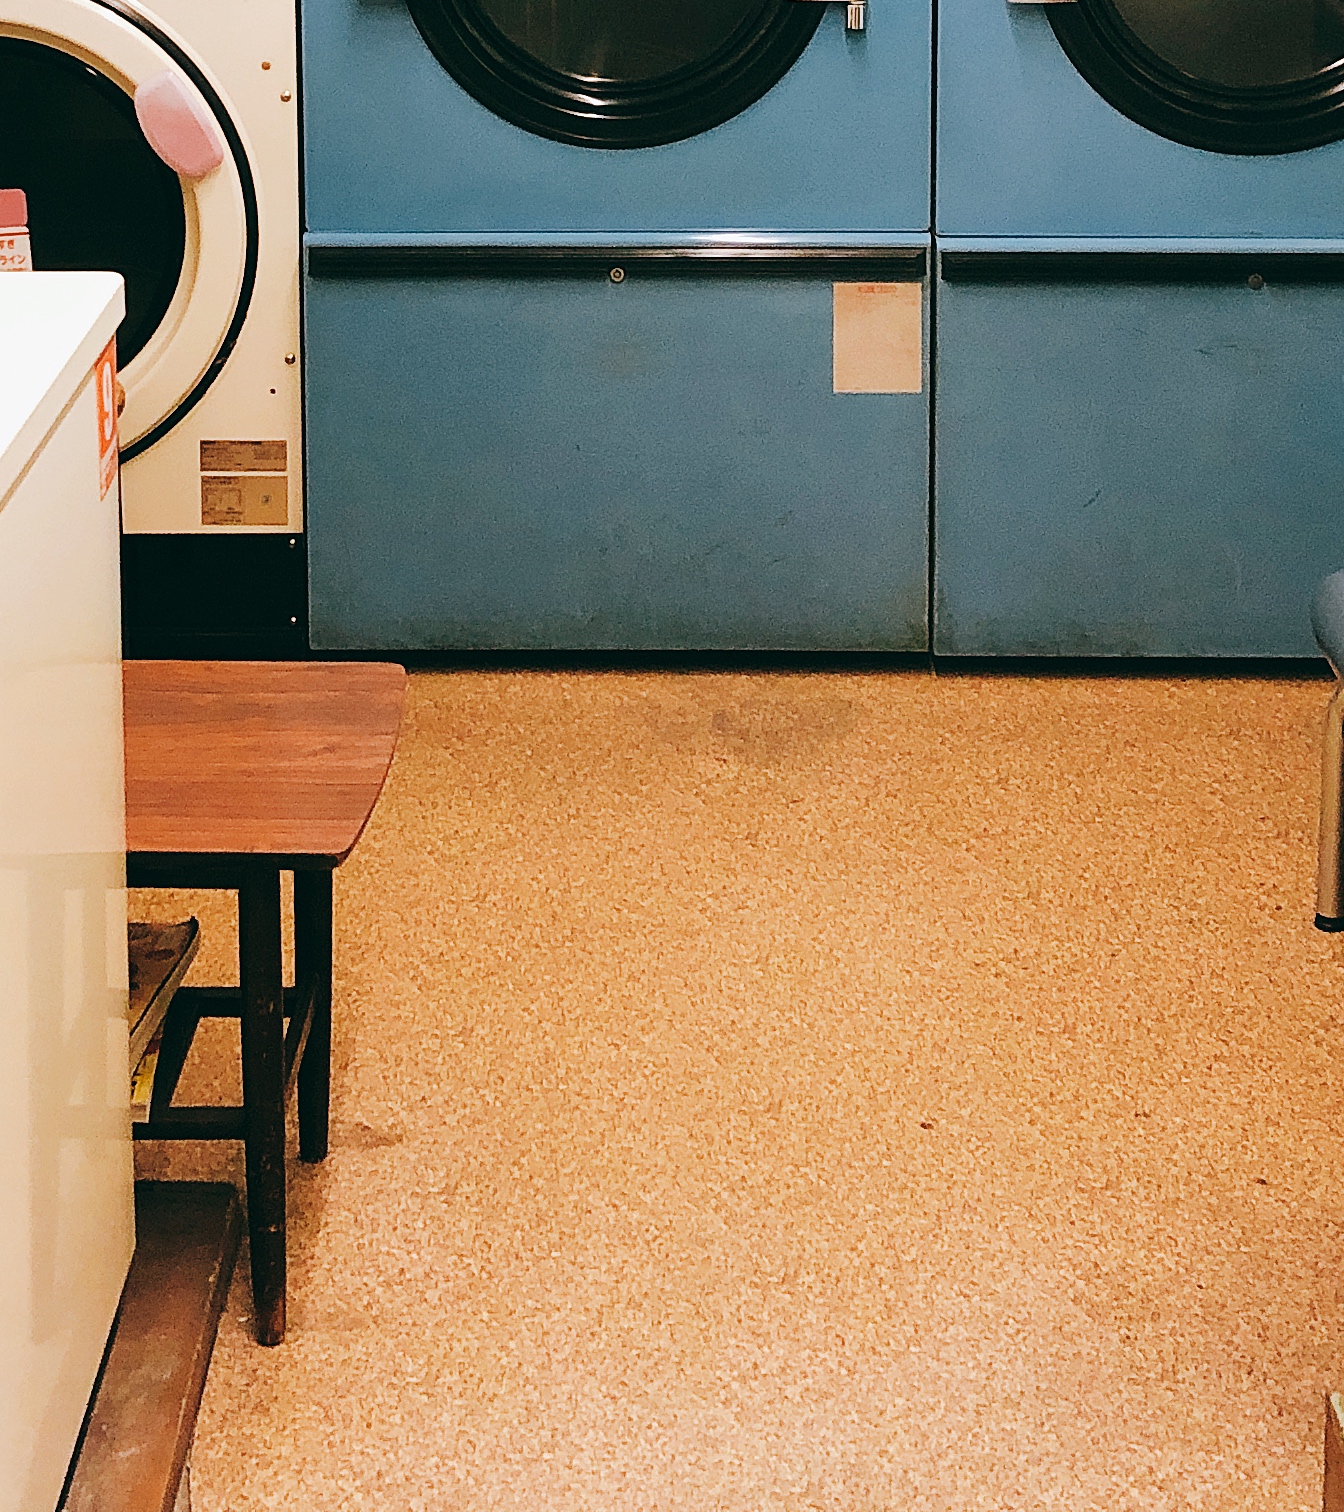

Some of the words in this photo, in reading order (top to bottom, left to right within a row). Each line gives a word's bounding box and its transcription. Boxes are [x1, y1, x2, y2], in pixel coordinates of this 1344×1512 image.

[0, 254, 26, 266] ライン
[101, 360, 114, 442] 9
